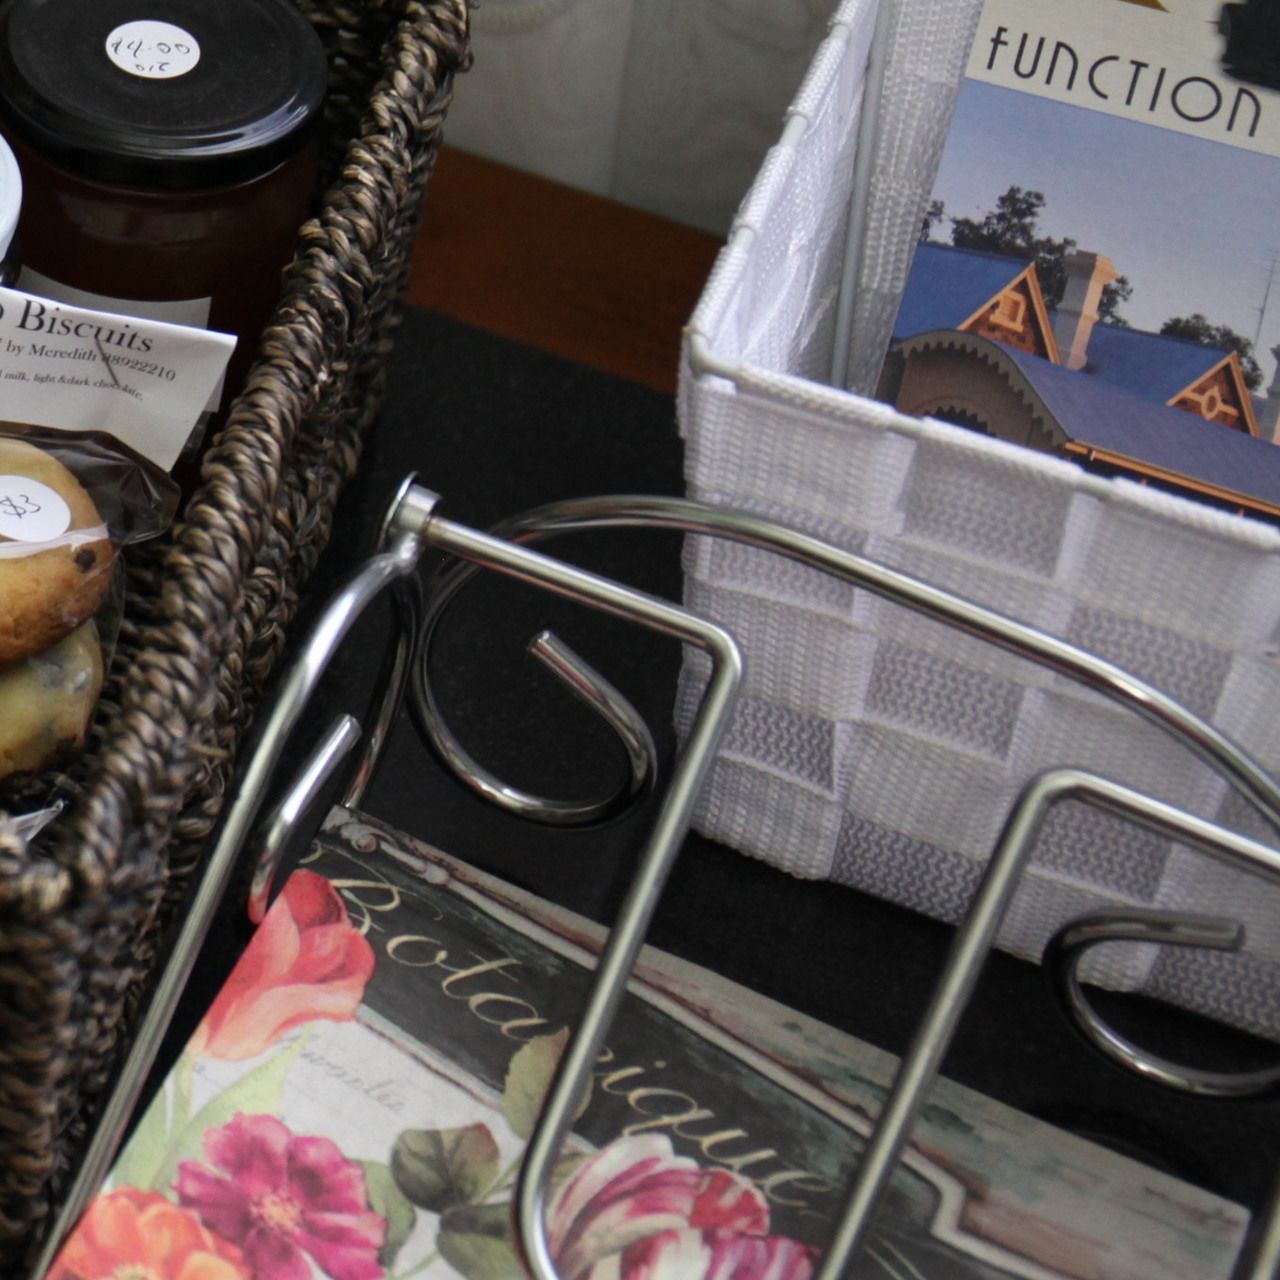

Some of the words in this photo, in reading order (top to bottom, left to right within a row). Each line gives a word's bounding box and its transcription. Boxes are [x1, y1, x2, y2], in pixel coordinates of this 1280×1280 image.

[987, 26, 1262, 138] FUNCTION
[6, 338, 25, 356] by
[28, 343, 97, 363] Meredith
[16, 298, 155, 354] Biscuits
[300, 838, 832, 1210] Botaique
